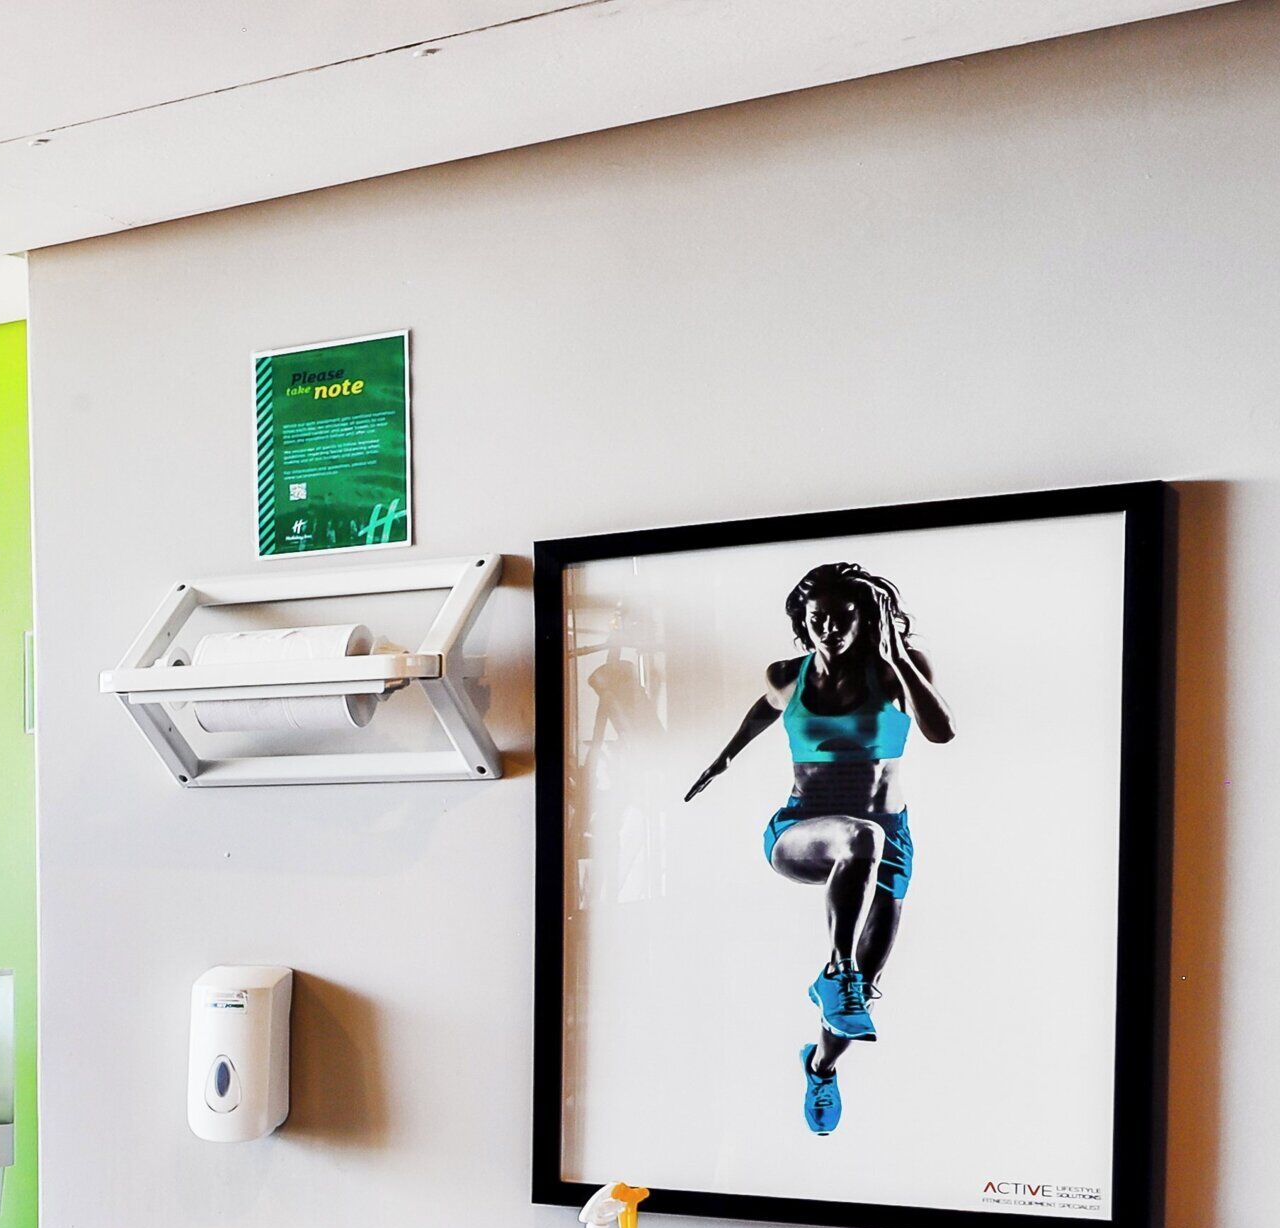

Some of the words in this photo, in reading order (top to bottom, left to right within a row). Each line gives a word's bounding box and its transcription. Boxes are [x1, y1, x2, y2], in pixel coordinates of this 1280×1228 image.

[290, 368, 344, 386] Please
[286, 385, 311, 396] take
[313, 377, 365, 400] note
[983, 1181, 1053, 1198] ACTIVE
[1056, 1185, 1102, 1194] LIFESTYLE
[1056, 1192, 1102, 1201] SOLUTIONS
[982, 1197, 1012, 1205] FITNESS
[1014, 1199, 1055, 1208] EQUIPMENT
[1058, 1202, 1100, 1211] SPECIALIST
